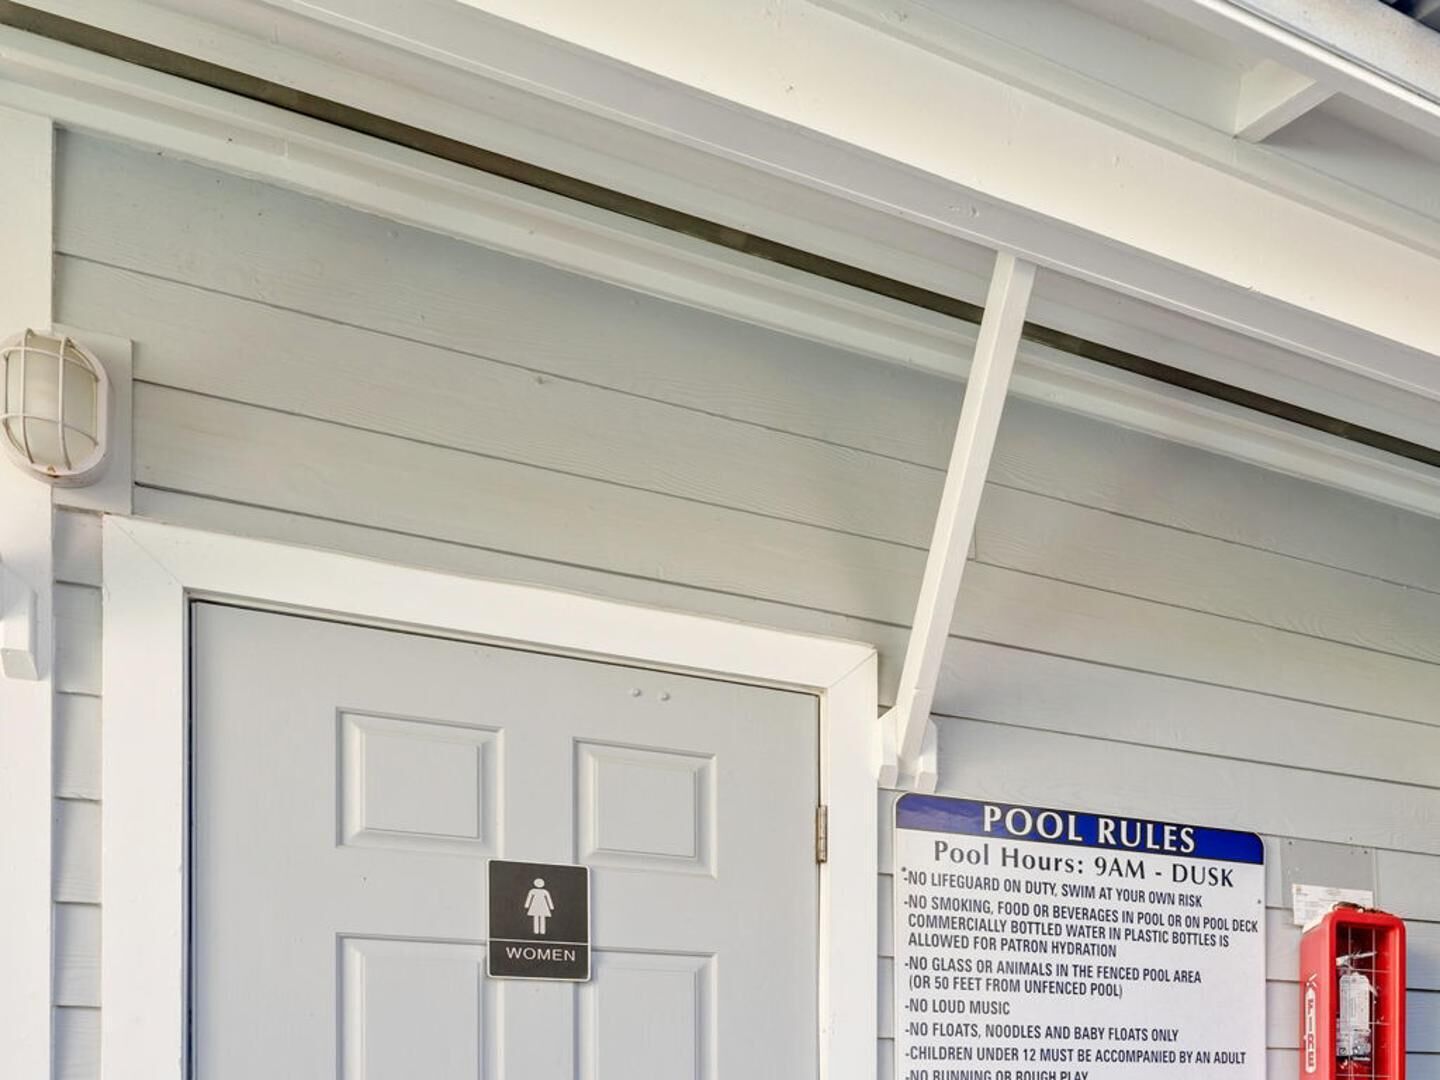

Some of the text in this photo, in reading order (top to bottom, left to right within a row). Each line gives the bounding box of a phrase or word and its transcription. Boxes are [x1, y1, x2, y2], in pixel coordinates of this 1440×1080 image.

[983, 805, 1195, 853] POOL RULES
[934, 840, 989, 865] Pool
[1001, 847, 1083, 874] Hours:
[1094, 857, 1145, 880] 9AM
[1172, 863, 1234, 888] DUSK
[931, 872, 1000, 891] LIFEGUARD
[1003, 879, 1021, 893] ON
[1025, 880, 1058, 896] DUTY,
[1061, 883, 1096, 900] SWIM
[1099, 887, 1113, 900] AT
[1116, 888, 1145, 904] YOUR
[1149, 891, 1175, 905] OWN
[1178, 894, 1202, 908] RISK
[931, 896, 994, 915] SMOKING,
[997, 901, 1030, 916] FOOD
[1033, 904, 1049, 918] OR
[1053, 906, 1118, 924] BEVERAGES
[1122, 910, 1134, 924] IN
[1137, 911, 1165, 926] POOL
[1167, 914, 1182, 927] OR
[1184, 915, 1200, 928] ON
[1203, 917, 1229, 931] POOL
[1232, 919, 1258, 933] DECK
[908, 913, 1229, 948] COMMERCIALLY BOTTLED WATER IN PLASTIC BOTTLES IS
[505, 946, 576, 961] WOMEN
[908, 932, 1117, 957] ALLOWED FOR PATRON HYDRATION
[931, 957, 973, 973] GLASS
[976, 959, 993, 974] OR
[996, 960, 1052, 977] ANIMALS
[1056, 963, 1068, 977] IN
[1072, 964, 1093, 978] THE
[1096, 965, 1140, 981] FENCED
[1142, 967, 1171, 982] POOL
[1173, 970, 1202, 983] AREA
[909, 974, 1123, 999] (OR 50 FEET FROM UNFENCED POOL)
[932, 999, 966, 1014] LOUD
[969, 1000, 1010, 1015] MUSIC
[932, 1023, 982, 1039] FLOATS,
[985, 1024, 1041, 1039] NOODLES
[1044, 1026, 1071, 1040] AND
[1074, 1026, 1105, 1040] BABY
[1108, 1027, 1148, 1041] FLOATS
[1151, 1028, 1179, 1042] ONLY
[1307, 998, 1315, 1067] FIRE
[976, 1047, 1019, 1061] UNDER
[1023, 1048, 1036, 1061] 12
[1039, 1048, 1074, 1062] MUST
[1077, 1049, 1092, 1062] BE
[1095, 1049, 1176, 1064] ACCOMPANIED
[1179, 1051, 1193, 1064] BY
[1195, 1051, 1211, 1064] AN
[1213, 1051, 1246, 1064] ADULT
